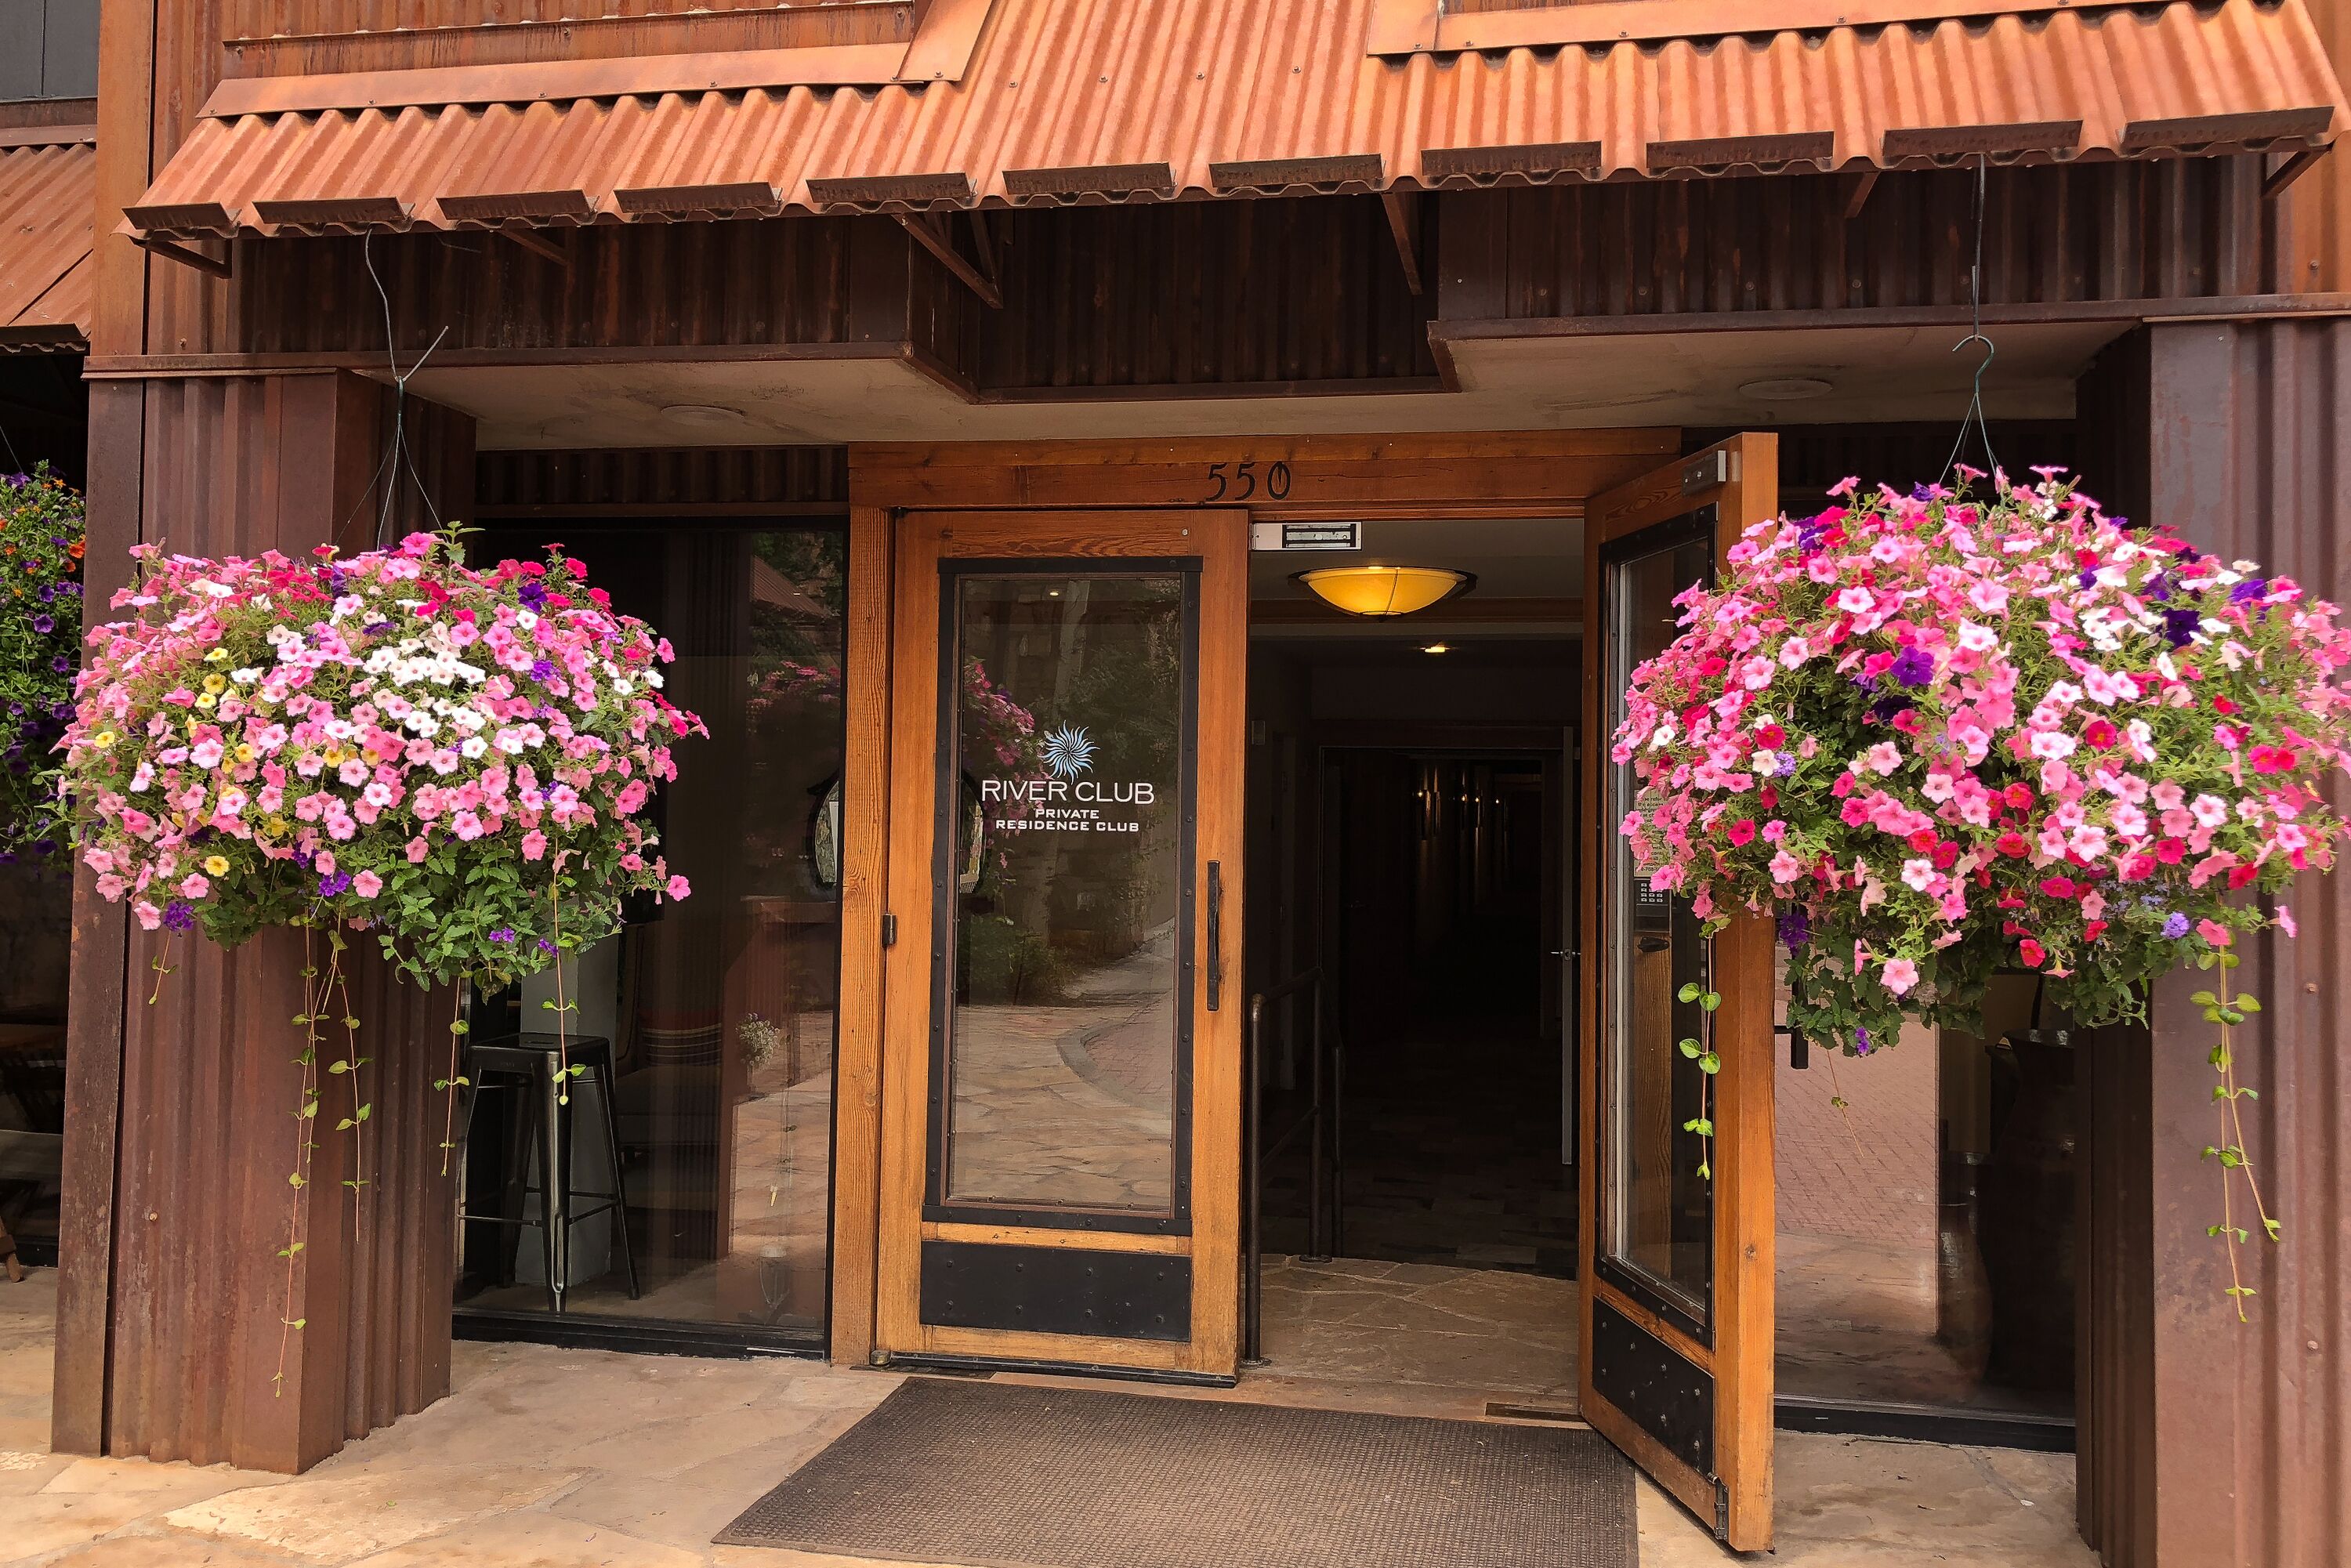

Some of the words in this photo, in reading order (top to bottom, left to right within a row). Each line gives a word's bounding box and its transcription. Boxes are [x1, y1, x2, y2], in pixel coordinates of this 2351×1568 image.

[1204, 461, 1291, 501] 550
[981, 779, 1068, 802] RIVER
[1074, 780, 1155, 806] CLUB
[1034, 809, 1099, 820] PRIVATE
[995, 820, 1090, 831] RESIDENCE
[1096, 821, 1139, 832] CLUB
